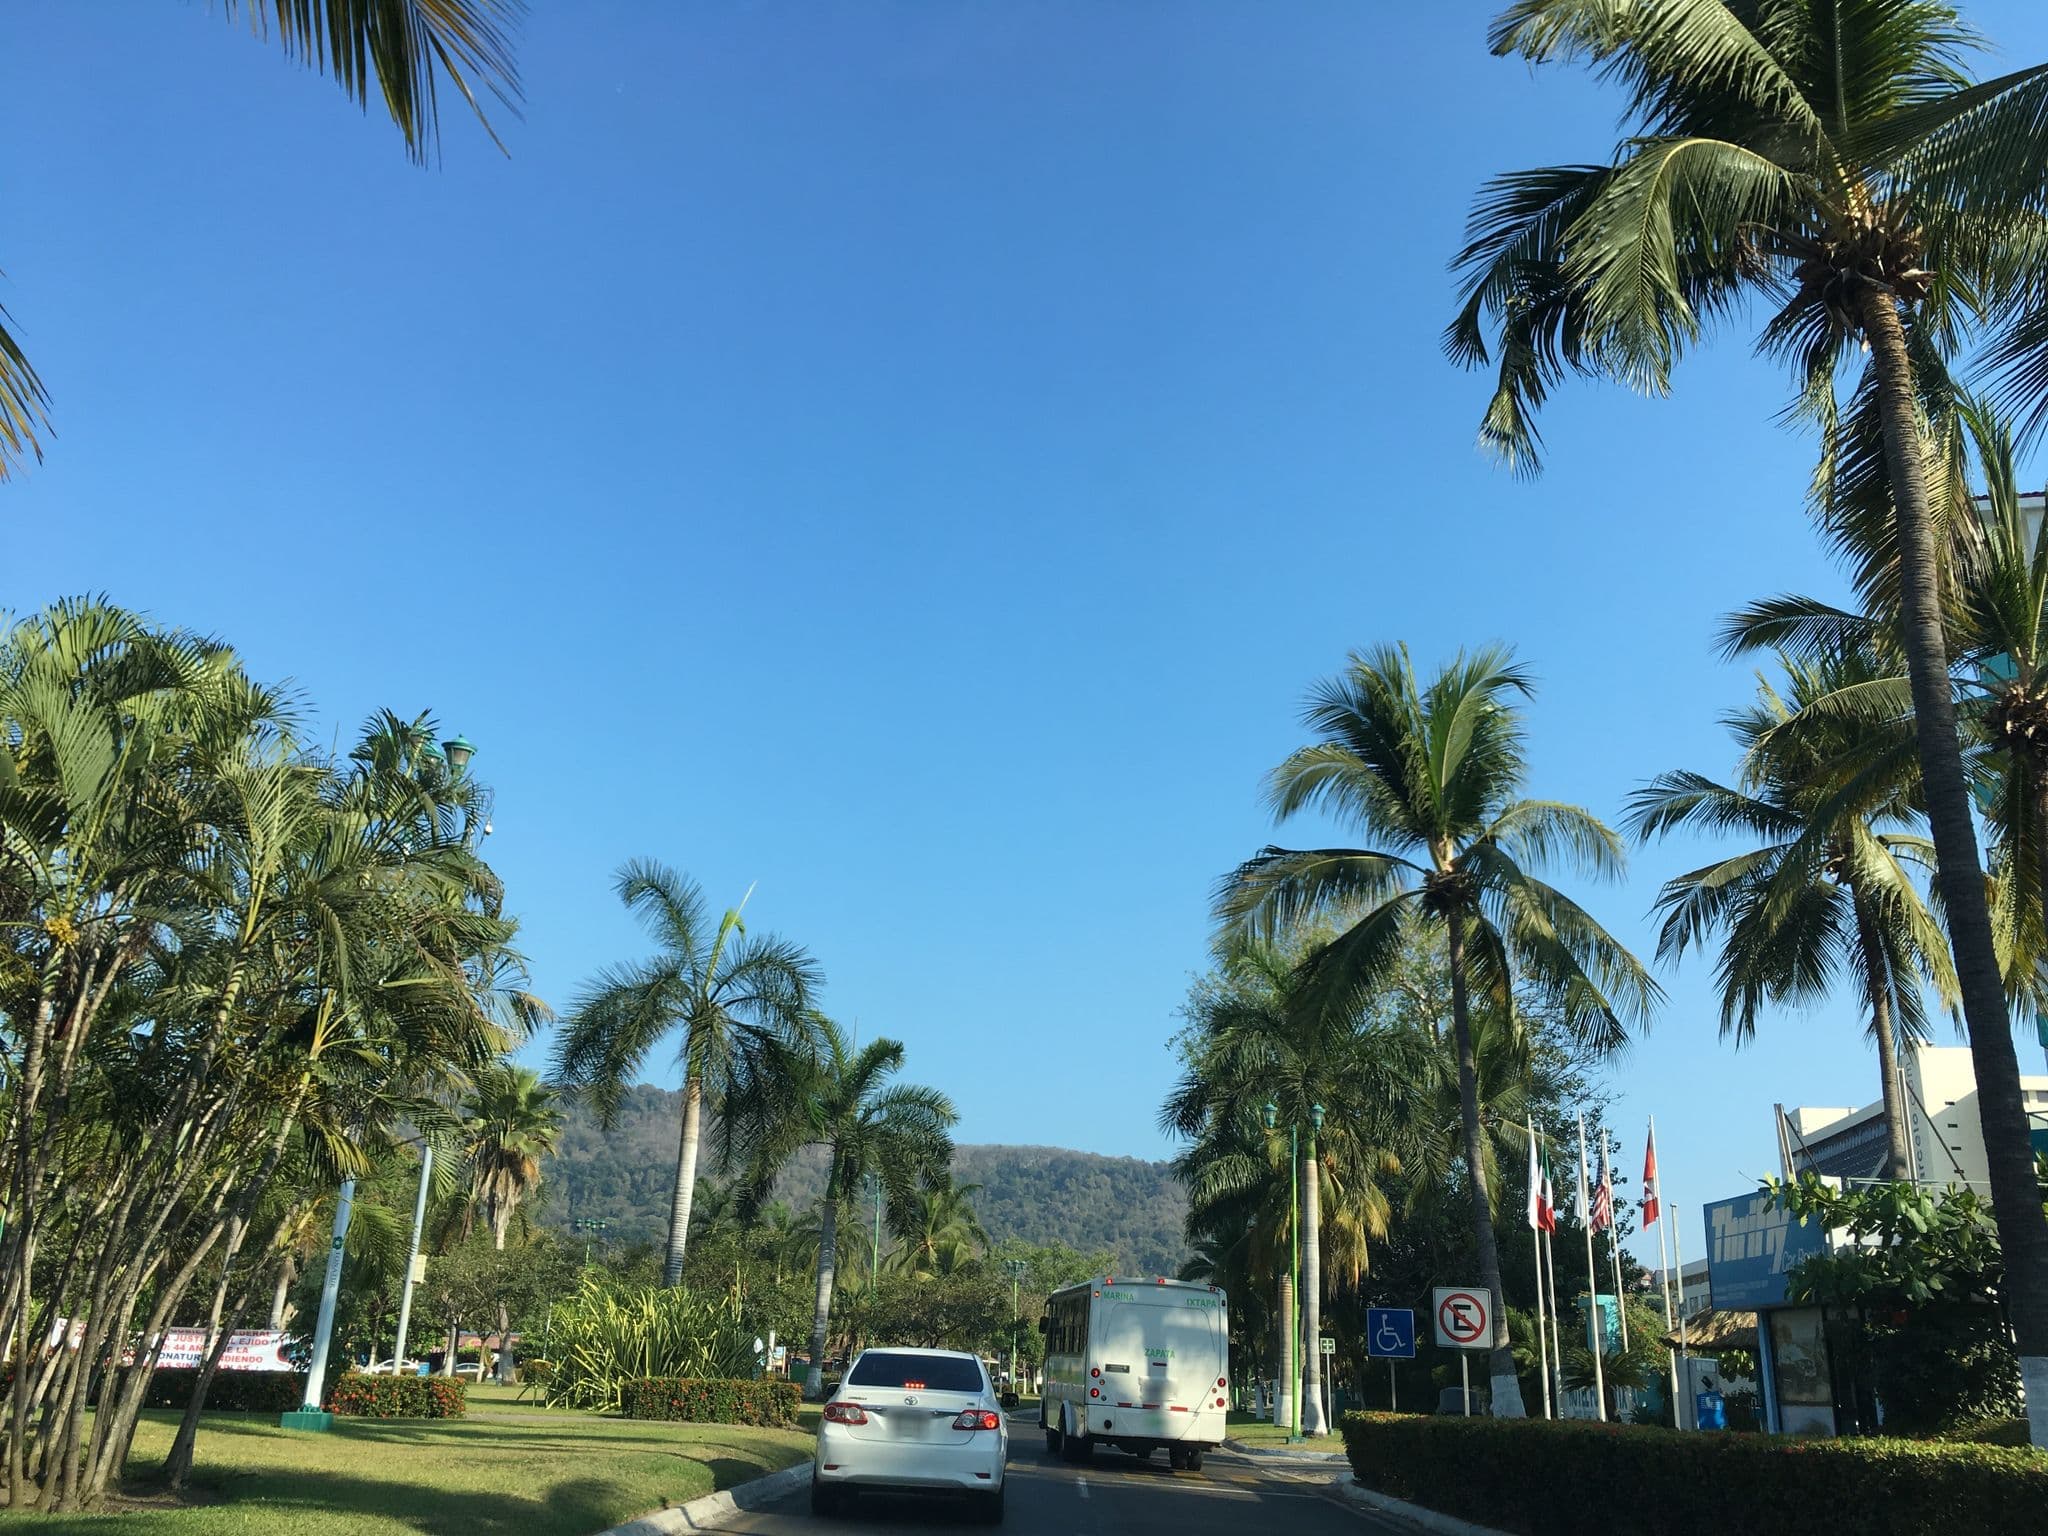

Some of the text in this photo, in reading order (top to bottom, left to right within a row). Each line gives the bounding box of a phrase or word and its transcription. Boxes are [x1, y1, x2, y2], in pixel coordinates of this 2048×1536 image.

[1711, 1197, 1790, 1275] Thrifty
[1103, 1290, 1134, 1301] MARINA
[1186, 1298, 1217, 1308] IXTAPA
[1453, 1304, 1473, 1332] E
[173, 1334, 203, 1343] JUSTI
[239, 1337, 269, 1346] EJIDO
[173, 1343, 185, 1351] 44
[236, 1346, 249, 1354] LA
[1144, 1347, 1176, 1359] ZAPATA
[159, 1351, 263, 1364] ONATUR DIENDO
